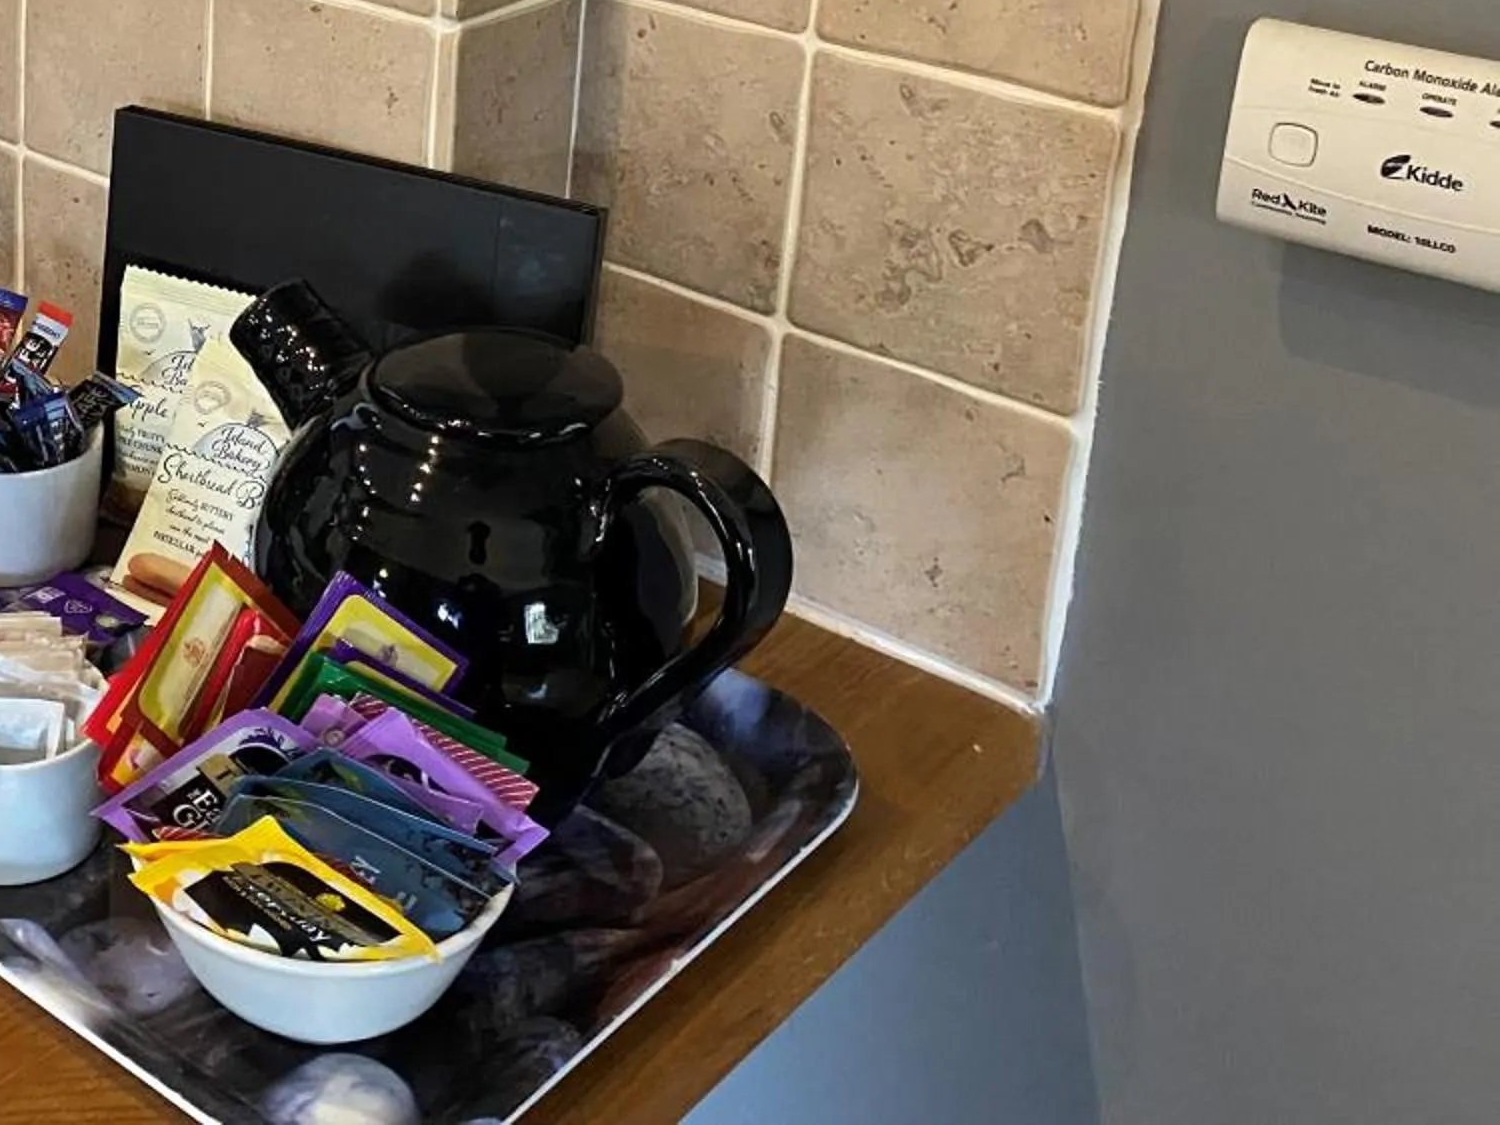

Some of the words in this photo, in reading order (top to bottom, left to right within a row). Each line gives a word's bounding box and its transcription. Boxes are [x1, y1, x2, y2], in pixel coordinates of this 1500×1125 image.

[1364, 59, 1409, 79] Carbon
[1413, 69, 1478, 92] Monoxide
[1480, 82, 1500, 97] Ala
[1407, 164, 1463, 192] Kidde
[1251, 188, 1281, 205] Red
[1298, 199, 1327, 217] Kite
[1368, 224, 1411, 243] MODEL:
[221, 426, 267, 452] Island
[212, 440, 270, 477] Bakery
[158, 452, 238, 495] Shortbread
